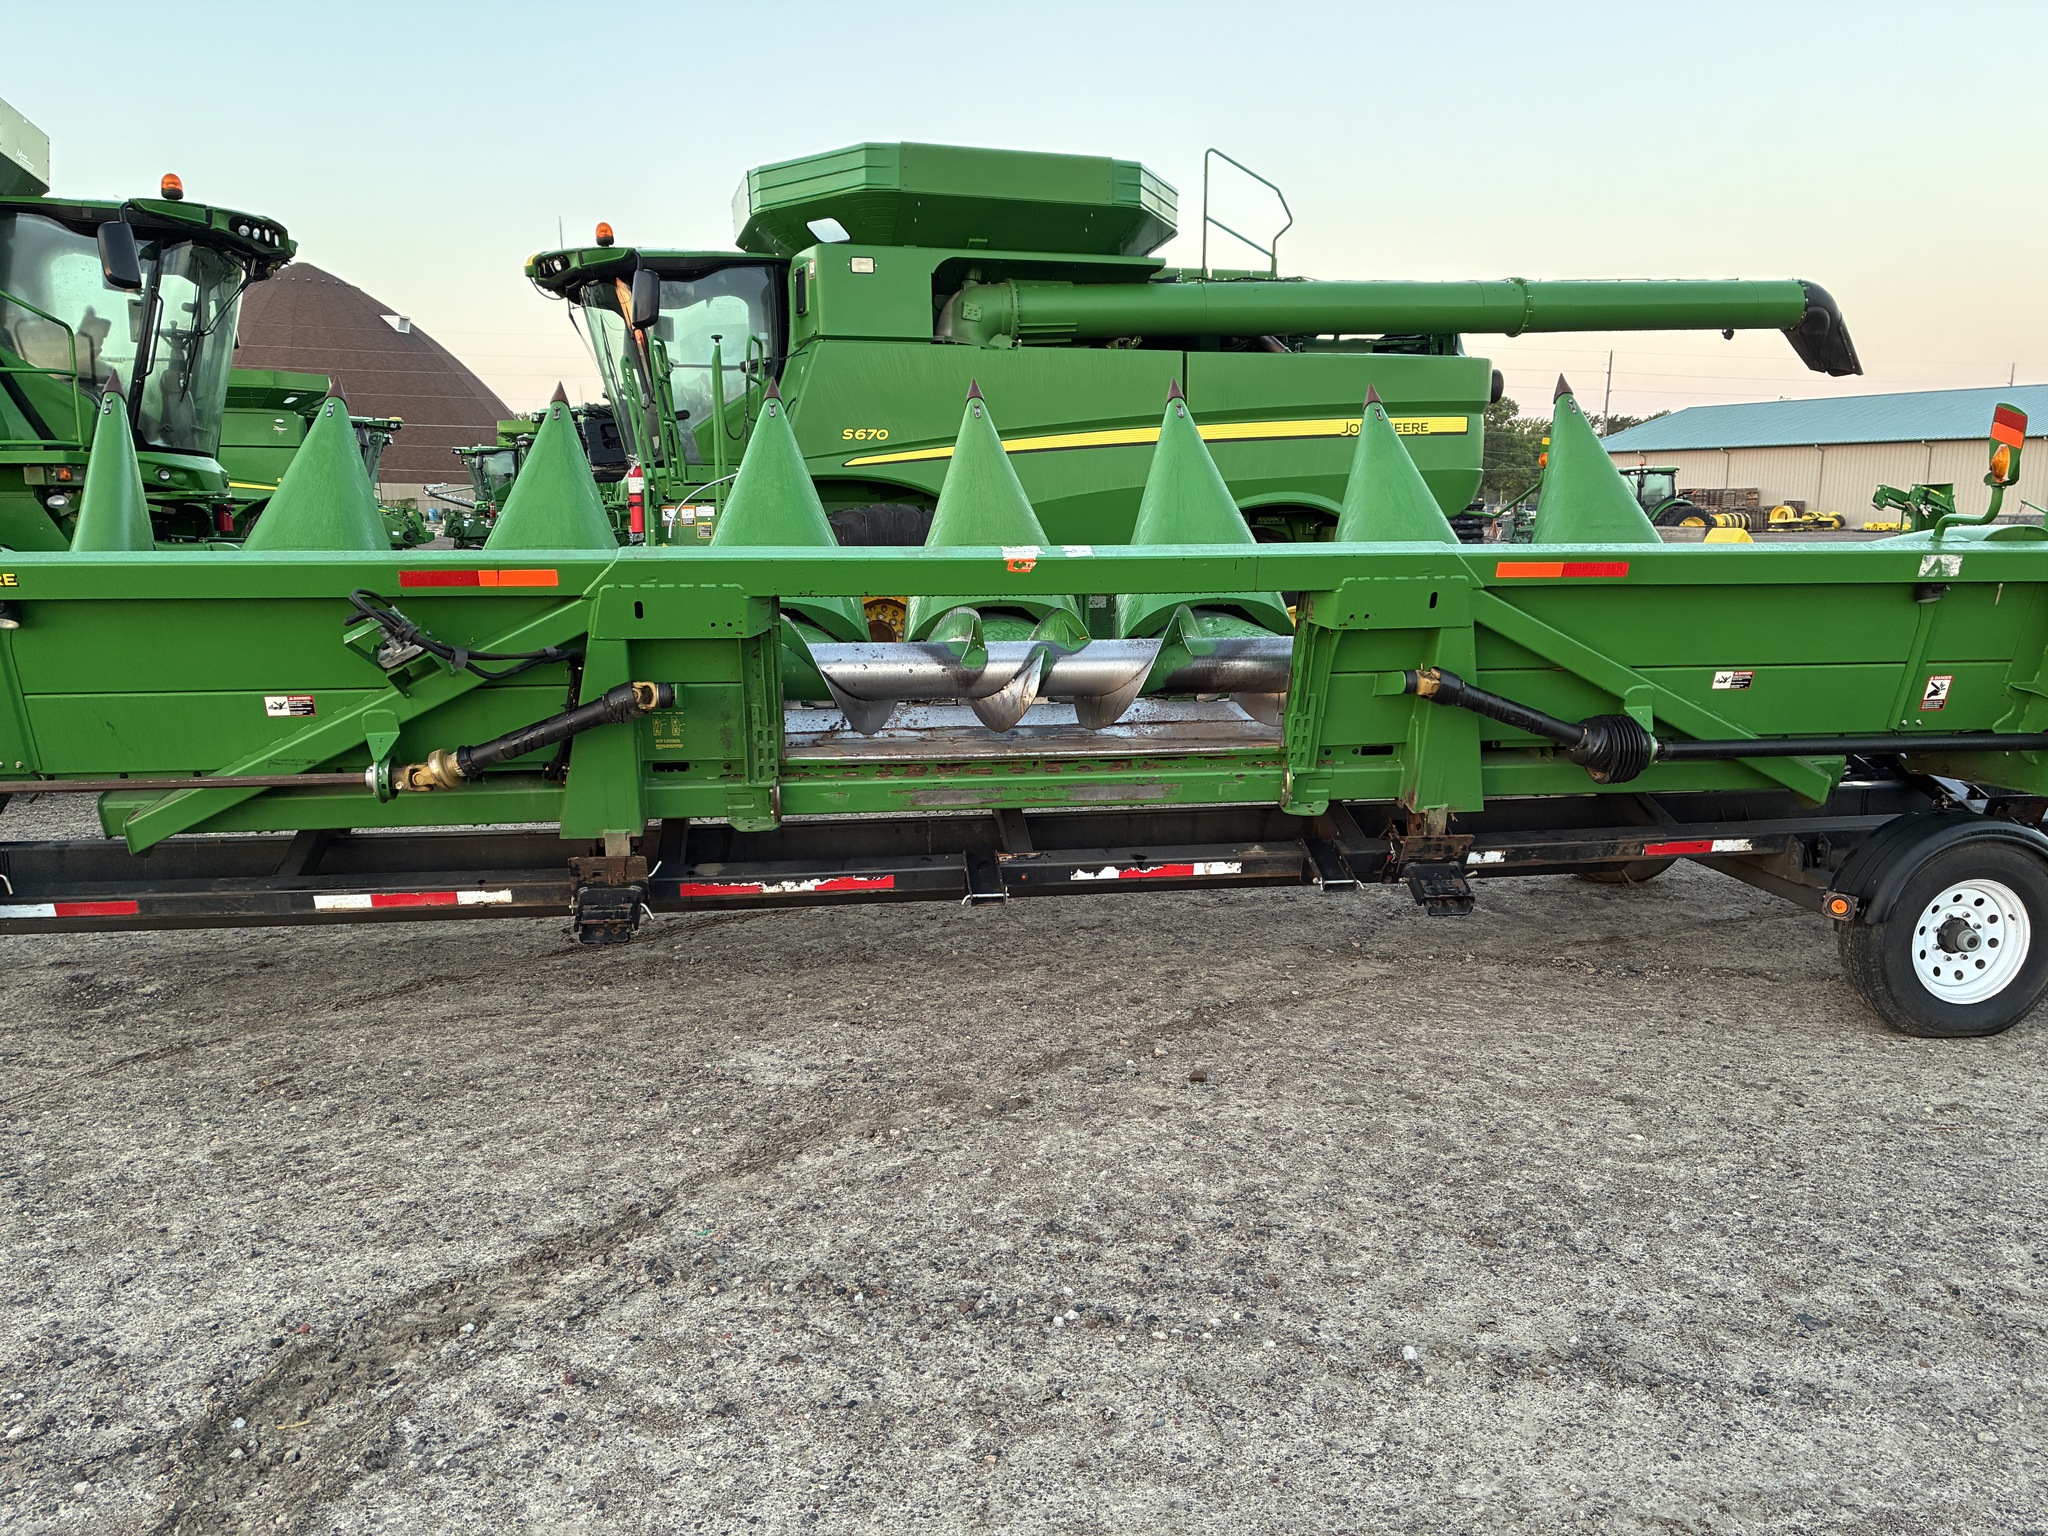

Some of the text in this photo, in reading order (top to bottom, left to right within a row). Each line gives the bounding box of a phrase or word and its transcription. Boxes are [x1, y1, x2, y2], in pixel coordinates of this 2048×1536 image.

[1340, 421, 1429, 434] JO EERE
[842, 428, 889, 441] S670
